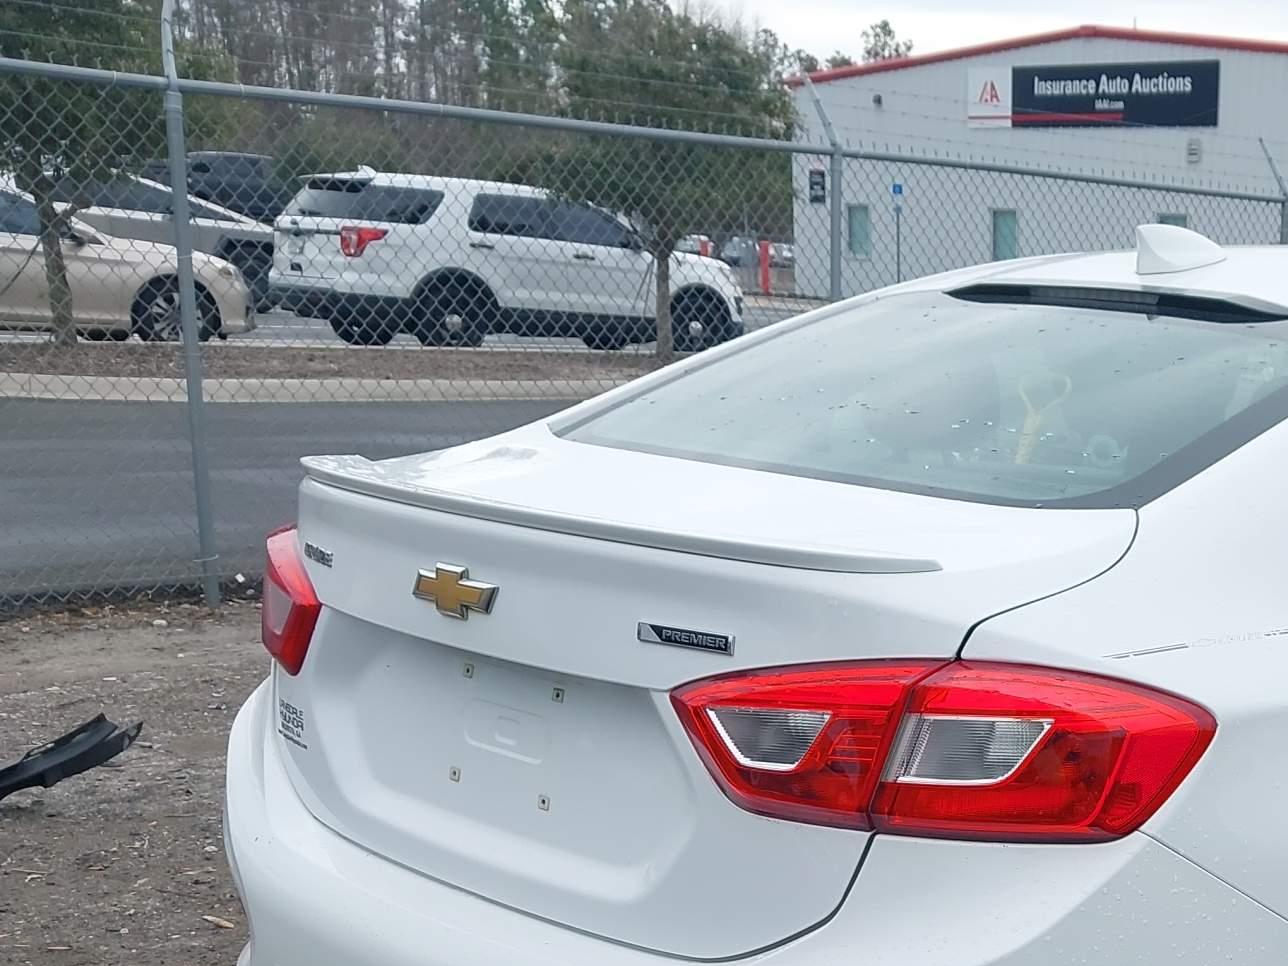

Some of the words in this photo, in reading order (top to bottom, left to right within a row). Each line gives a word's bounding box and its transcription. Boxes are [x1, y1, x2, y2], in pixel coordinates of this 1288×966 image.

[1034, 75, 1096, 96] Insurance
[1099, 73, 1129, 94] Auto
[1132, 72, 1192, 93] Auctions
[662, 629, 726, 648] PREMIER
